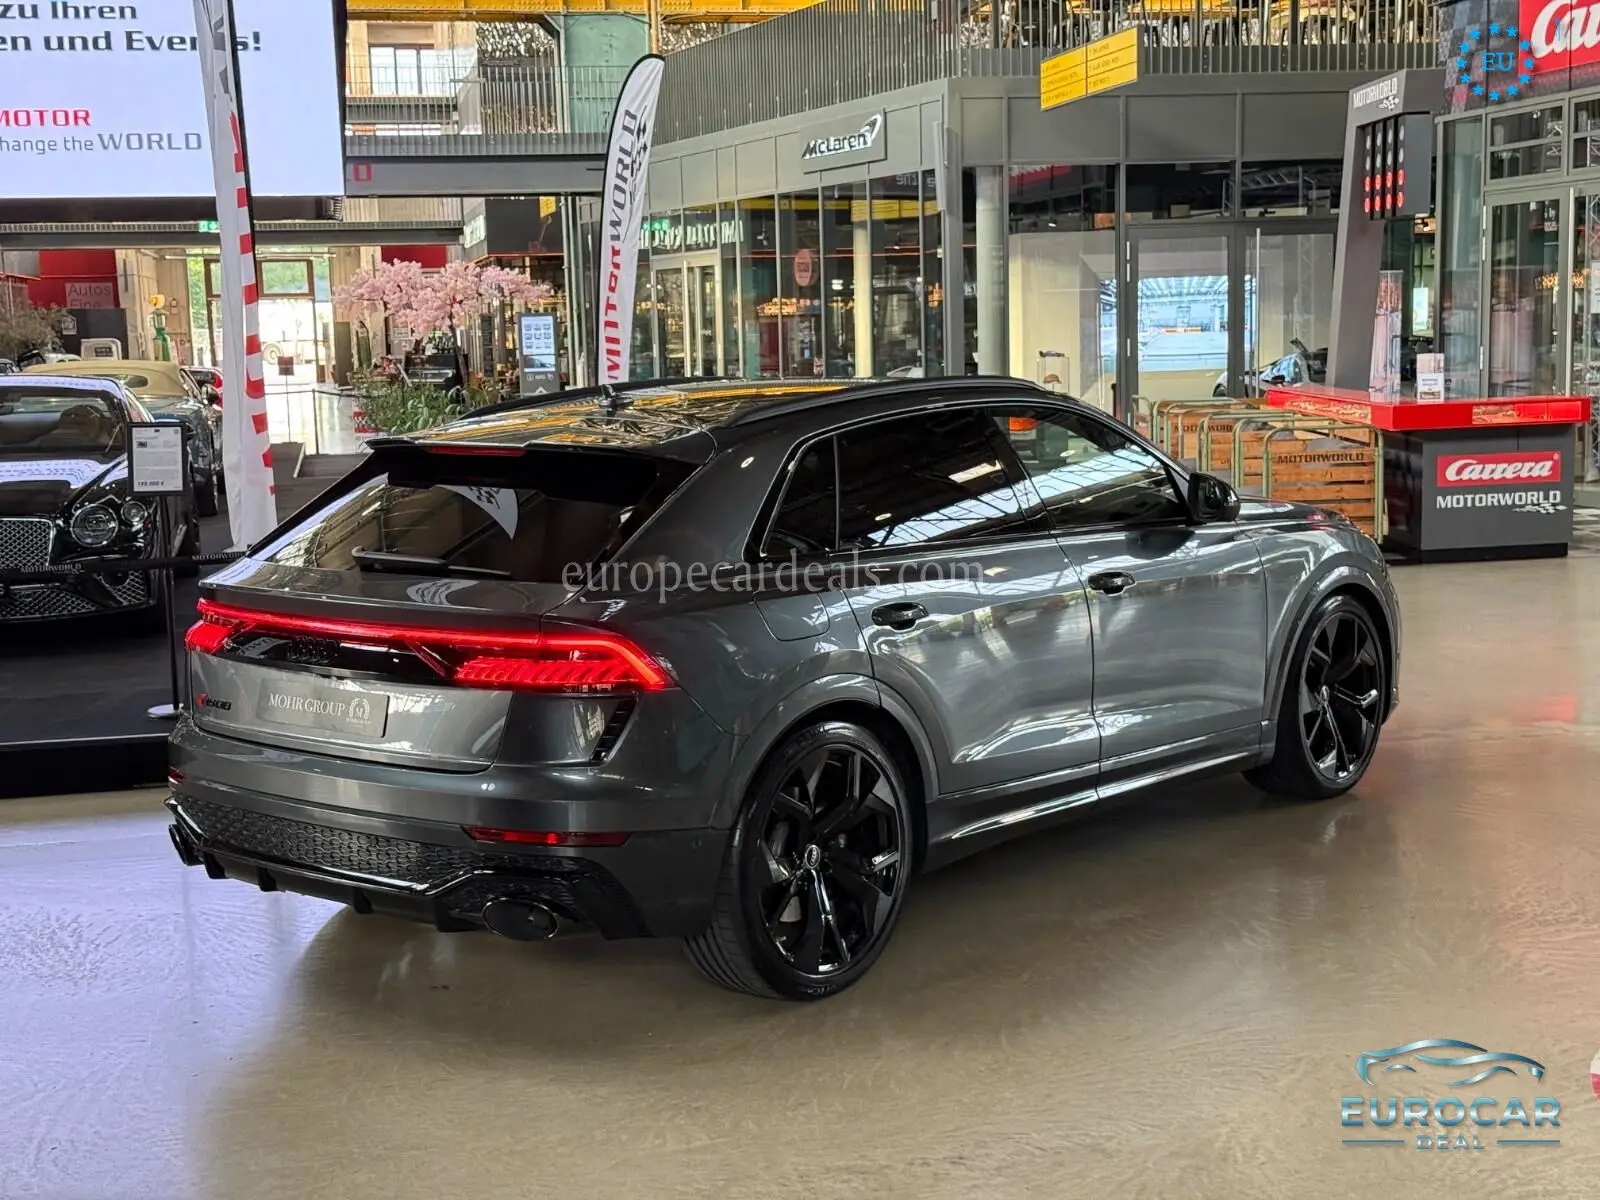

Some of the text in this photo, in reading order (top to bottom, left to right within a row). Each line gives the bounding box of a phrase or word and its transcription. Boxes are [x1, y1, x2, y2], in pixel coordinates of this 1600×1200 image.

[51, 1, 138, 19] Ihren
[44, 30, 112, 51] und
[1352, 77, 1398, 109] MOTORWORLD
[63, 136, 95, 152] the
[97, 132, 203, 151] WORLD
[801, 132, 869, 160] McLaren
[69, 283, 112, 297] Autos
[1277, 452, 1365, 465] MOTORWORLD
[1445, 458, 1554, 482] Carrera
[1436, 489, 1562, 510] MOTORWORLD
[268, 692, 346, 717] MOHR GROUP
